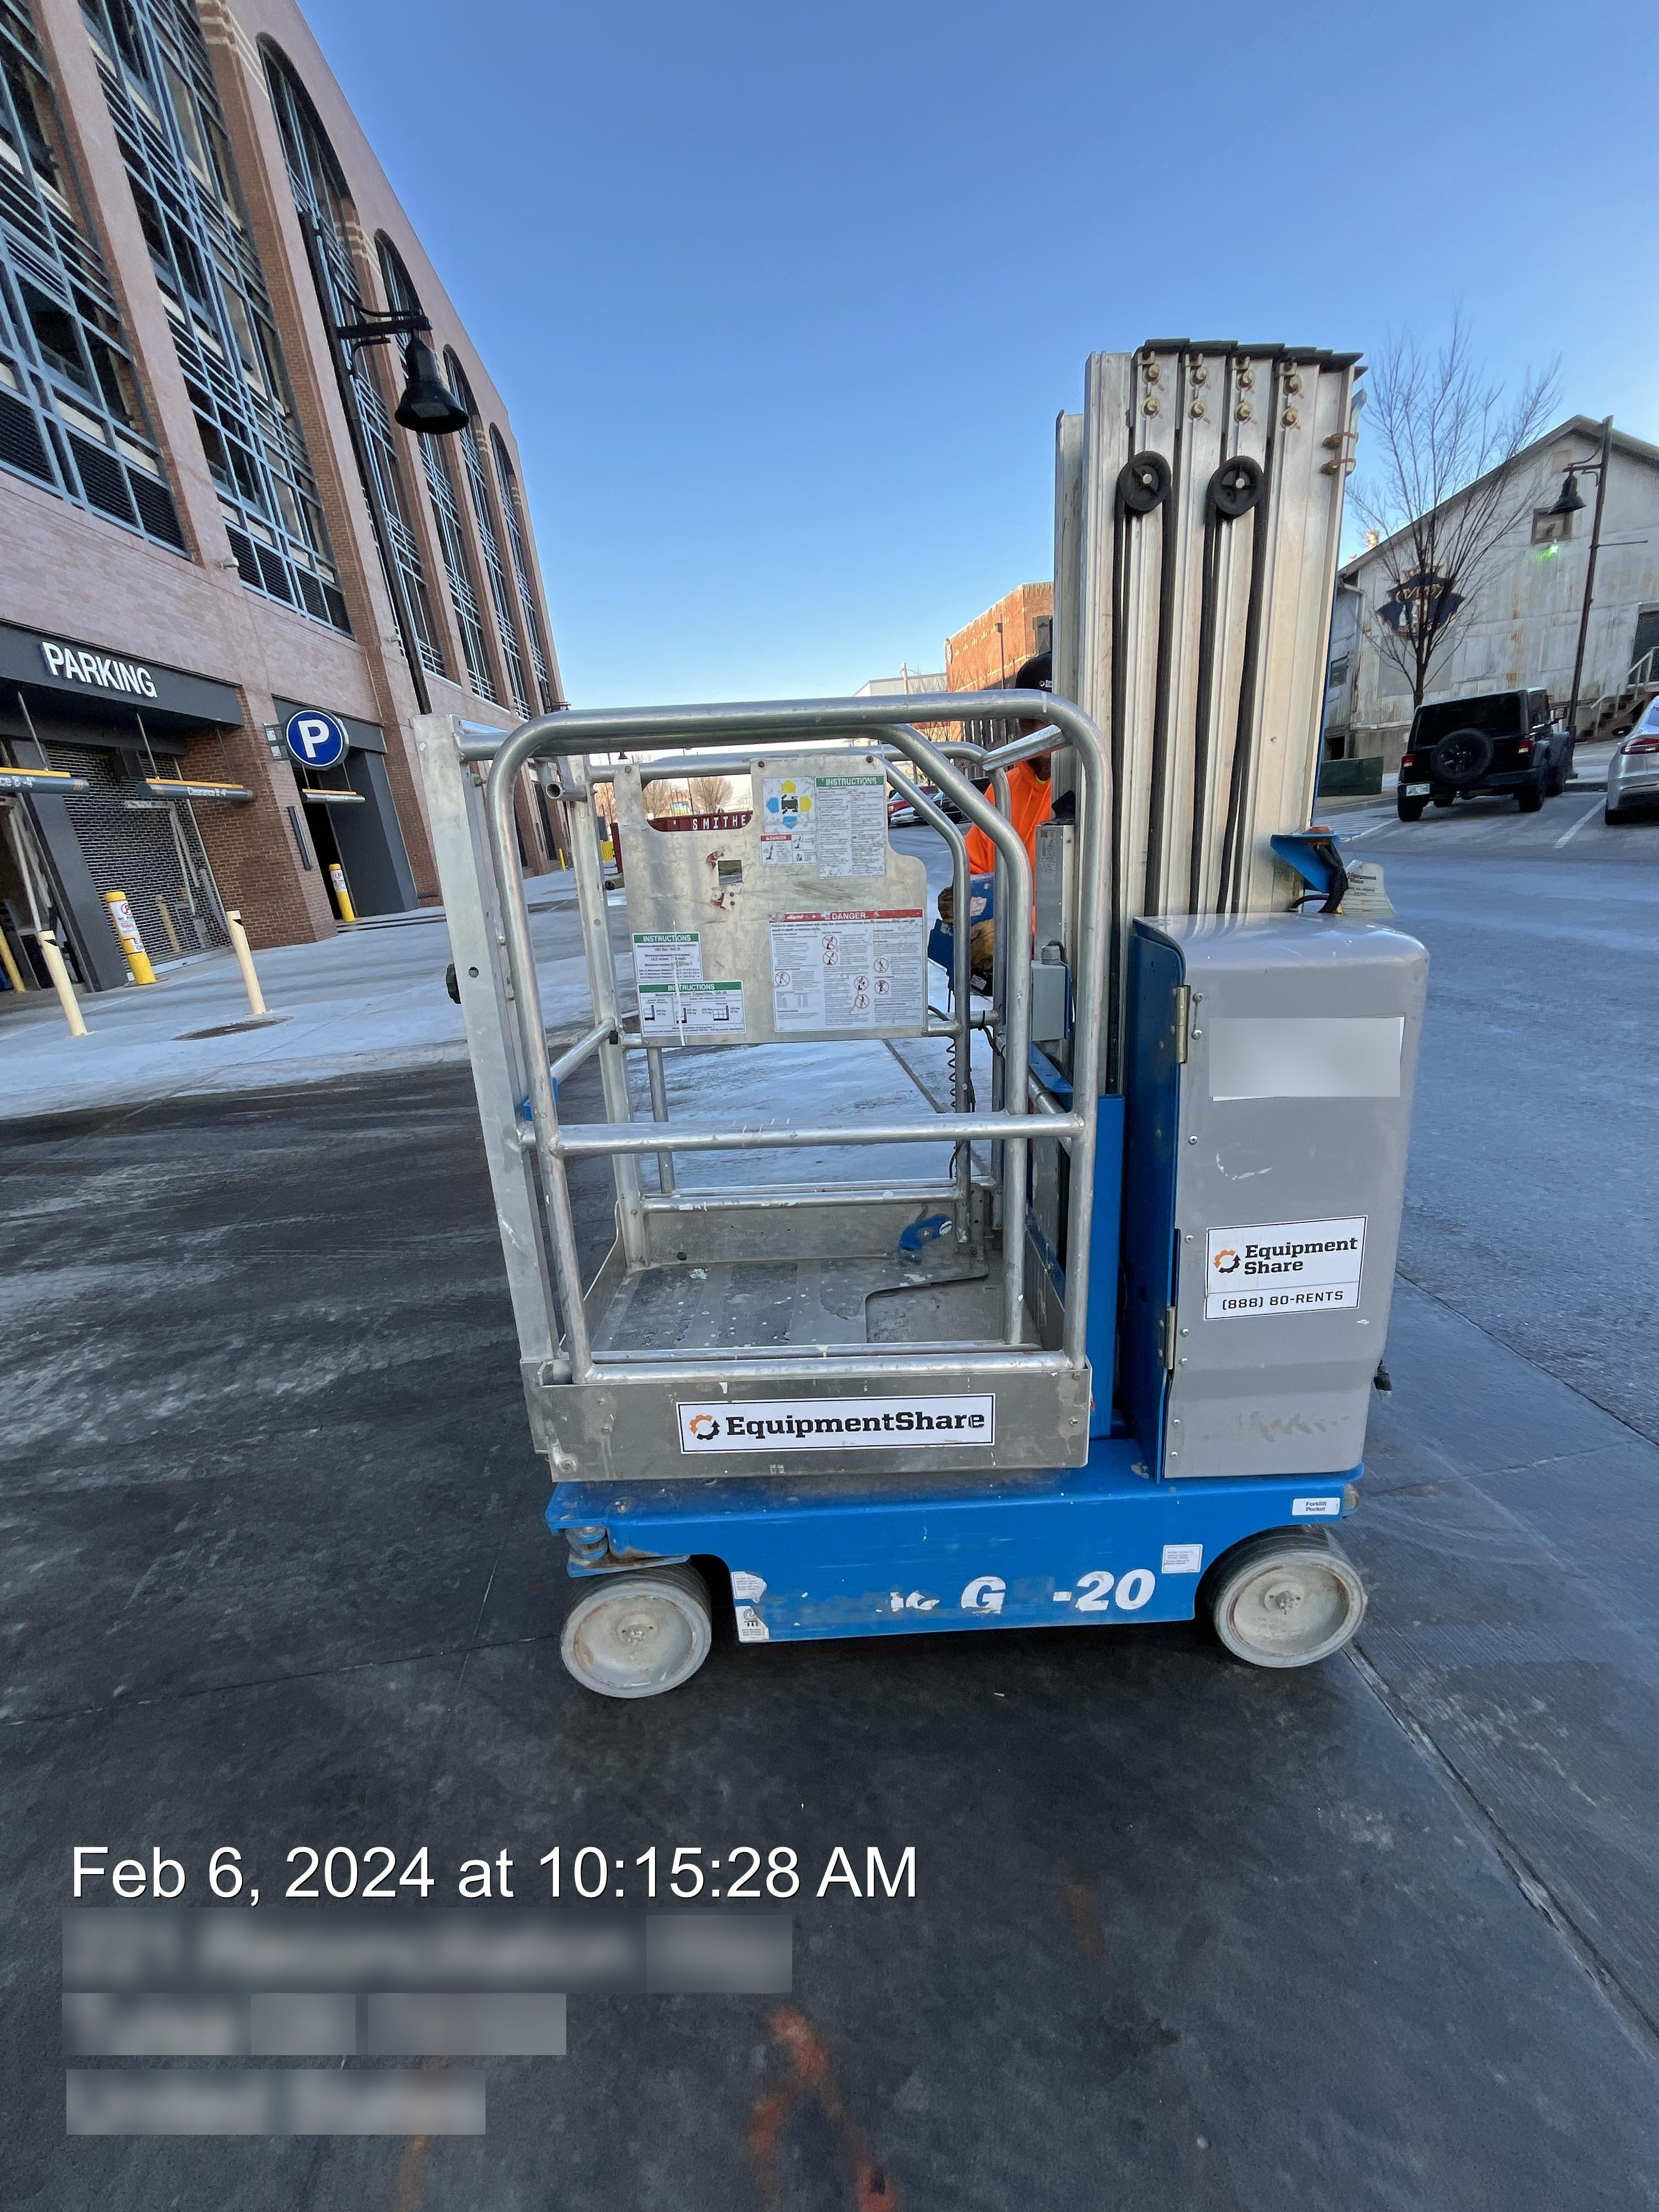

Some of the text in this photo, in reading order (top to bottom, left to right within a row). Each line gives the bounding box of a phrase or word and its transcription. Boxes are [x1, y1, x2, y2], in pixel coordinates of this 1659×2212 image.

[42, 641, 158, 698] PARKING
[297, 719, 330, 759] P
[826, 776, 877, 786] INSTRUCTIONS
[692, 814, 753, 831] SMITHE
[832, 911, 866, 920] DANGER
[643, 934, 691, 943] INSTRUCTIONS
[667, 983, 715, 992] INTRUCTIONS
[1245, 1237, 1358, 1260] Equipment
[1244, 1259, 1304, 1276] Share
[1222, 1291, 1344, 1310] (888) 80-RENTS
[725, 1410, 985, 1440] EquipmentShare
[961, 1568, 1156, 1614] G-20
